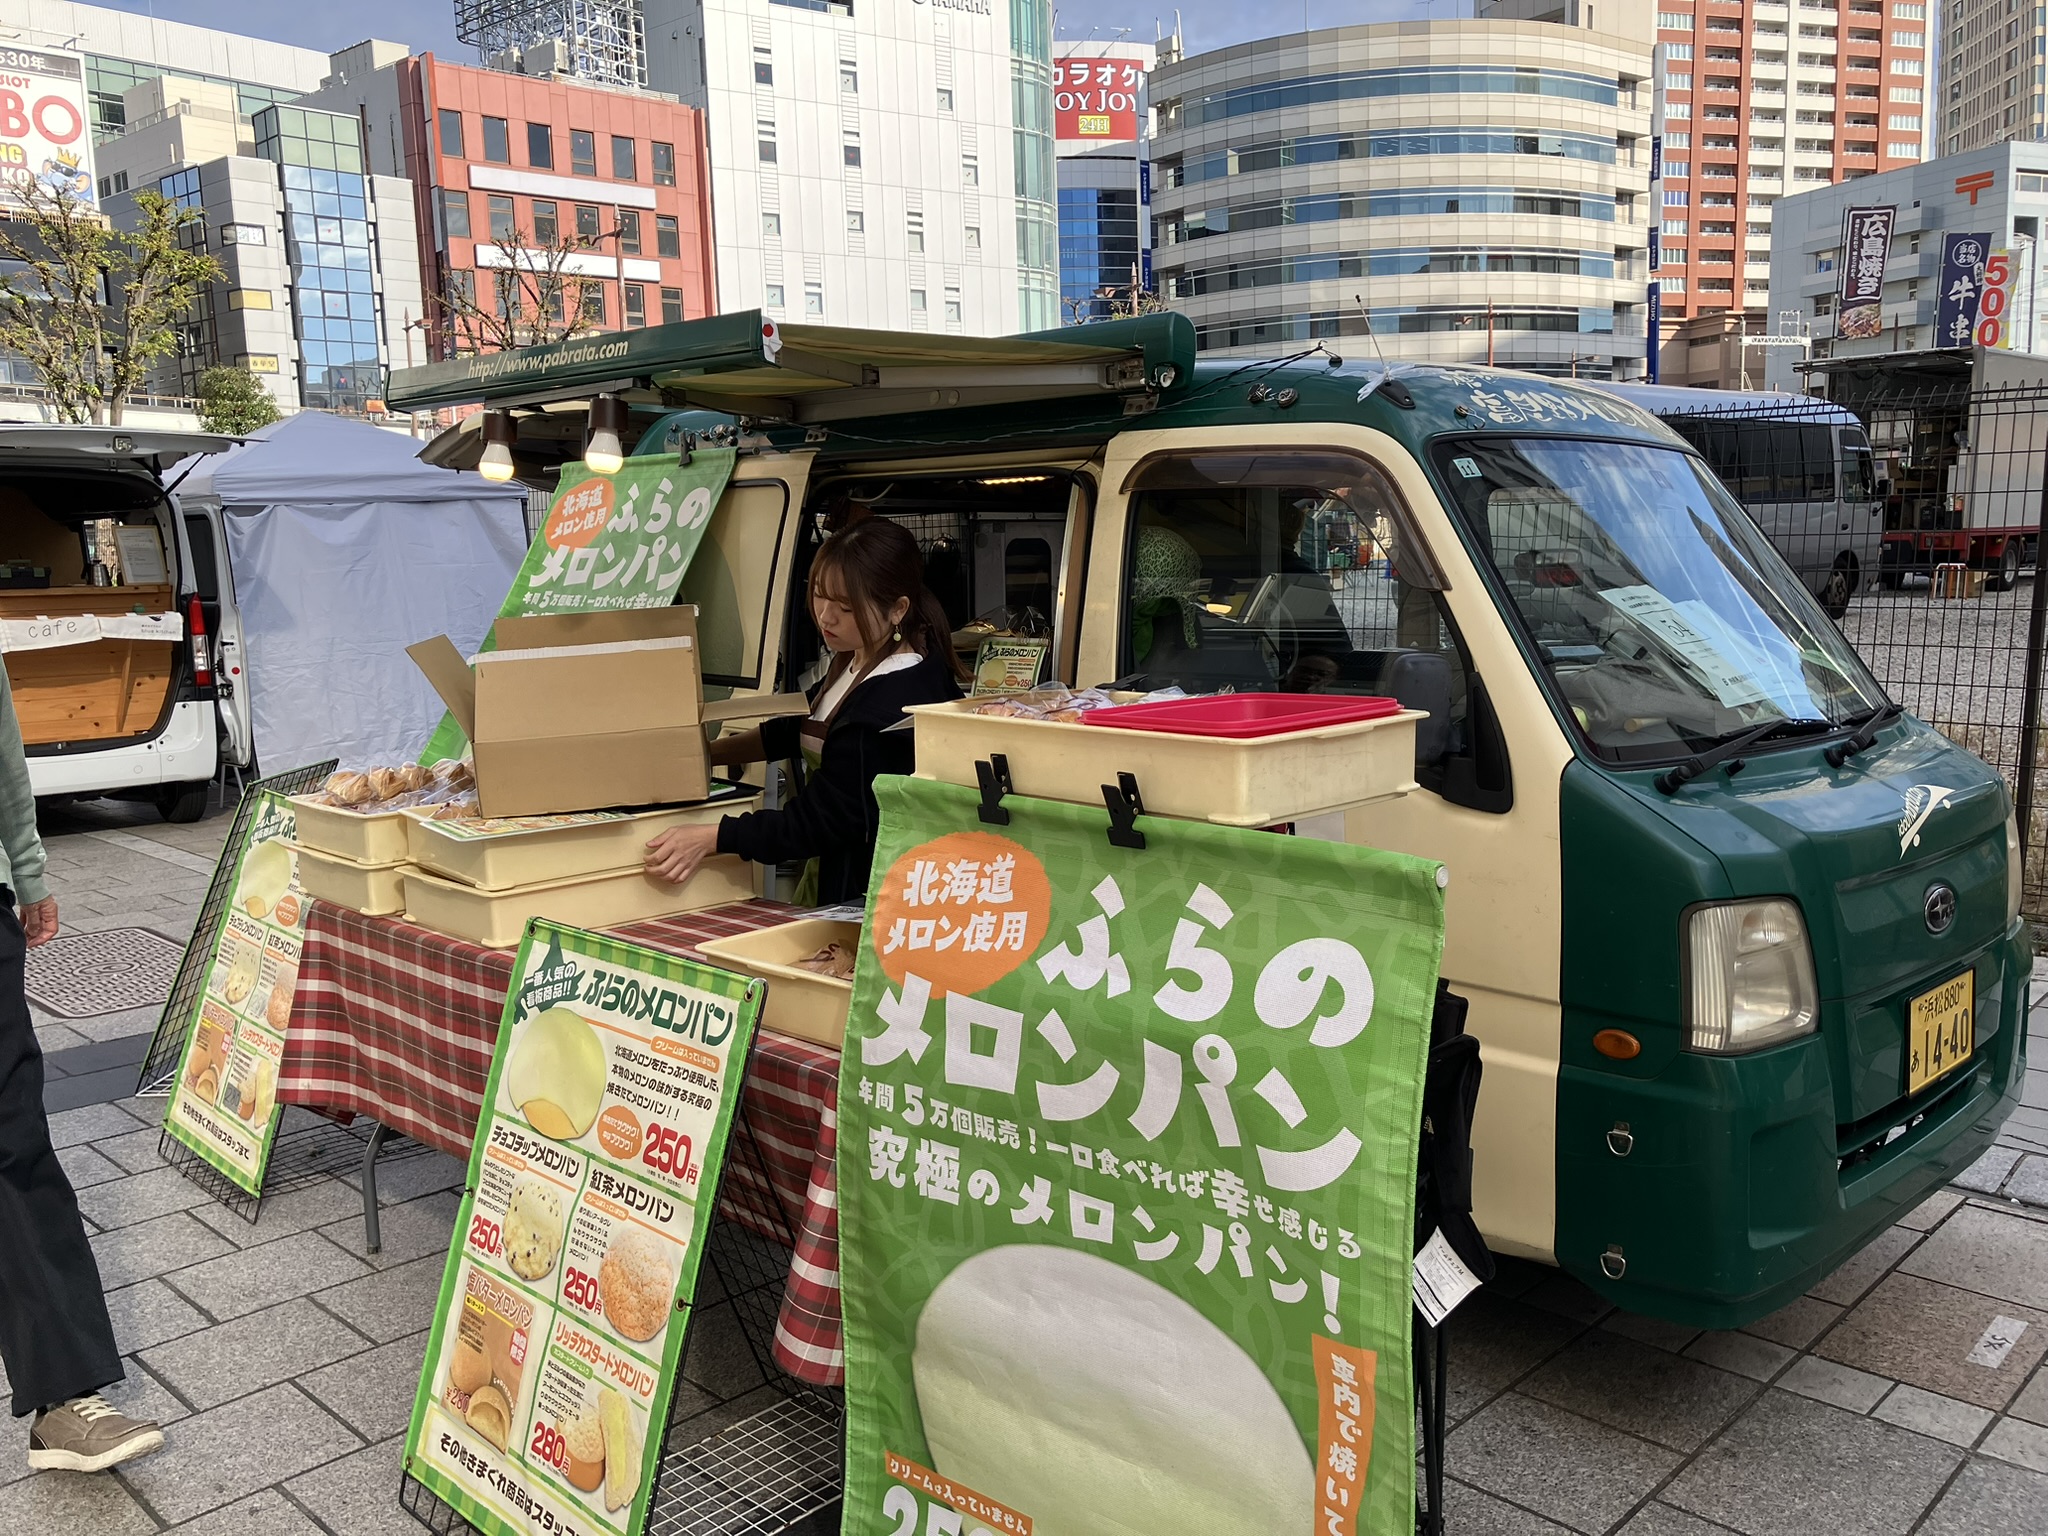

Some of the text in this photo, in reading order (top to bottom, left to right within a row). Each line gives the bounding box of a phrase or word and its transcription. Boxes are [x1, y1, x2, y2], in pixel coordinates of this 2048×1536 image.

[1055, 88, 1137, 112] OY JOY
[1079, 117, 1108, 132] 24H
[1857, 214, 1888, 295] 広島焼き
[1958, 254, 1976, 264] 名物
[1959, 243, 1977, 254] 当店
[1948, 275, 1976, 346] 牛串
[1977, 255, 2009, 347] 500
[468, 340, 629, 382] http://www.pabrata.com
[550, 507, 607, 540] メロン使用
[562, 483, 605, 517] 北海道
[606, 477, 711, 534] ふらの
[529, 535, 691, 591] メロンパン
[28, 620, 77, 639] cafe
[903, 852, 1014, 907] 北海道
[883, 911, 1028, 955] メロン使用
[525, 962, 576, 987] 一番人気の
[1036, 874, 1374, 1048] ふらの
[526, 980, 572, 1007] 看板商品!!
[582, 969, 733, 1046] ふらのメロンパン
[1924, 982, 1960, 1022] 浜松 880
[615, 1044, 719, 1093] 北海道メロンをたっぷり使用した、
[655, 1041, 717, 1069] クリームは入っていません
[1911, 1008, 1969, 1078] あ 14-40
[606, 1081, 680, 1121] 焼きたてメロンパン！！
[611, 1063, 712, 1111] 本物のメロンの味がする究極の
[861, 971, 1362, 1191] メロンパン
[491, 1125, 580, 1178] チョコチップメロンパン
[589, 1168, 674, 1222] 紅茶メロンパン
[867, 1125, 1341, 1335] 究極のメロンパン！
[466, 1269, 533, 1328] 塩バターメロンパン
[556, 1321, 654, 1397] リッチカスタードメロンパン
[1323, 1352, 1362, 1536] 車内で焼いて
[441, 1433, 582, 1536] その他きまぐれ商品はスタッフ
[890, 1459, 1028, 1536] クリームは入っていません
